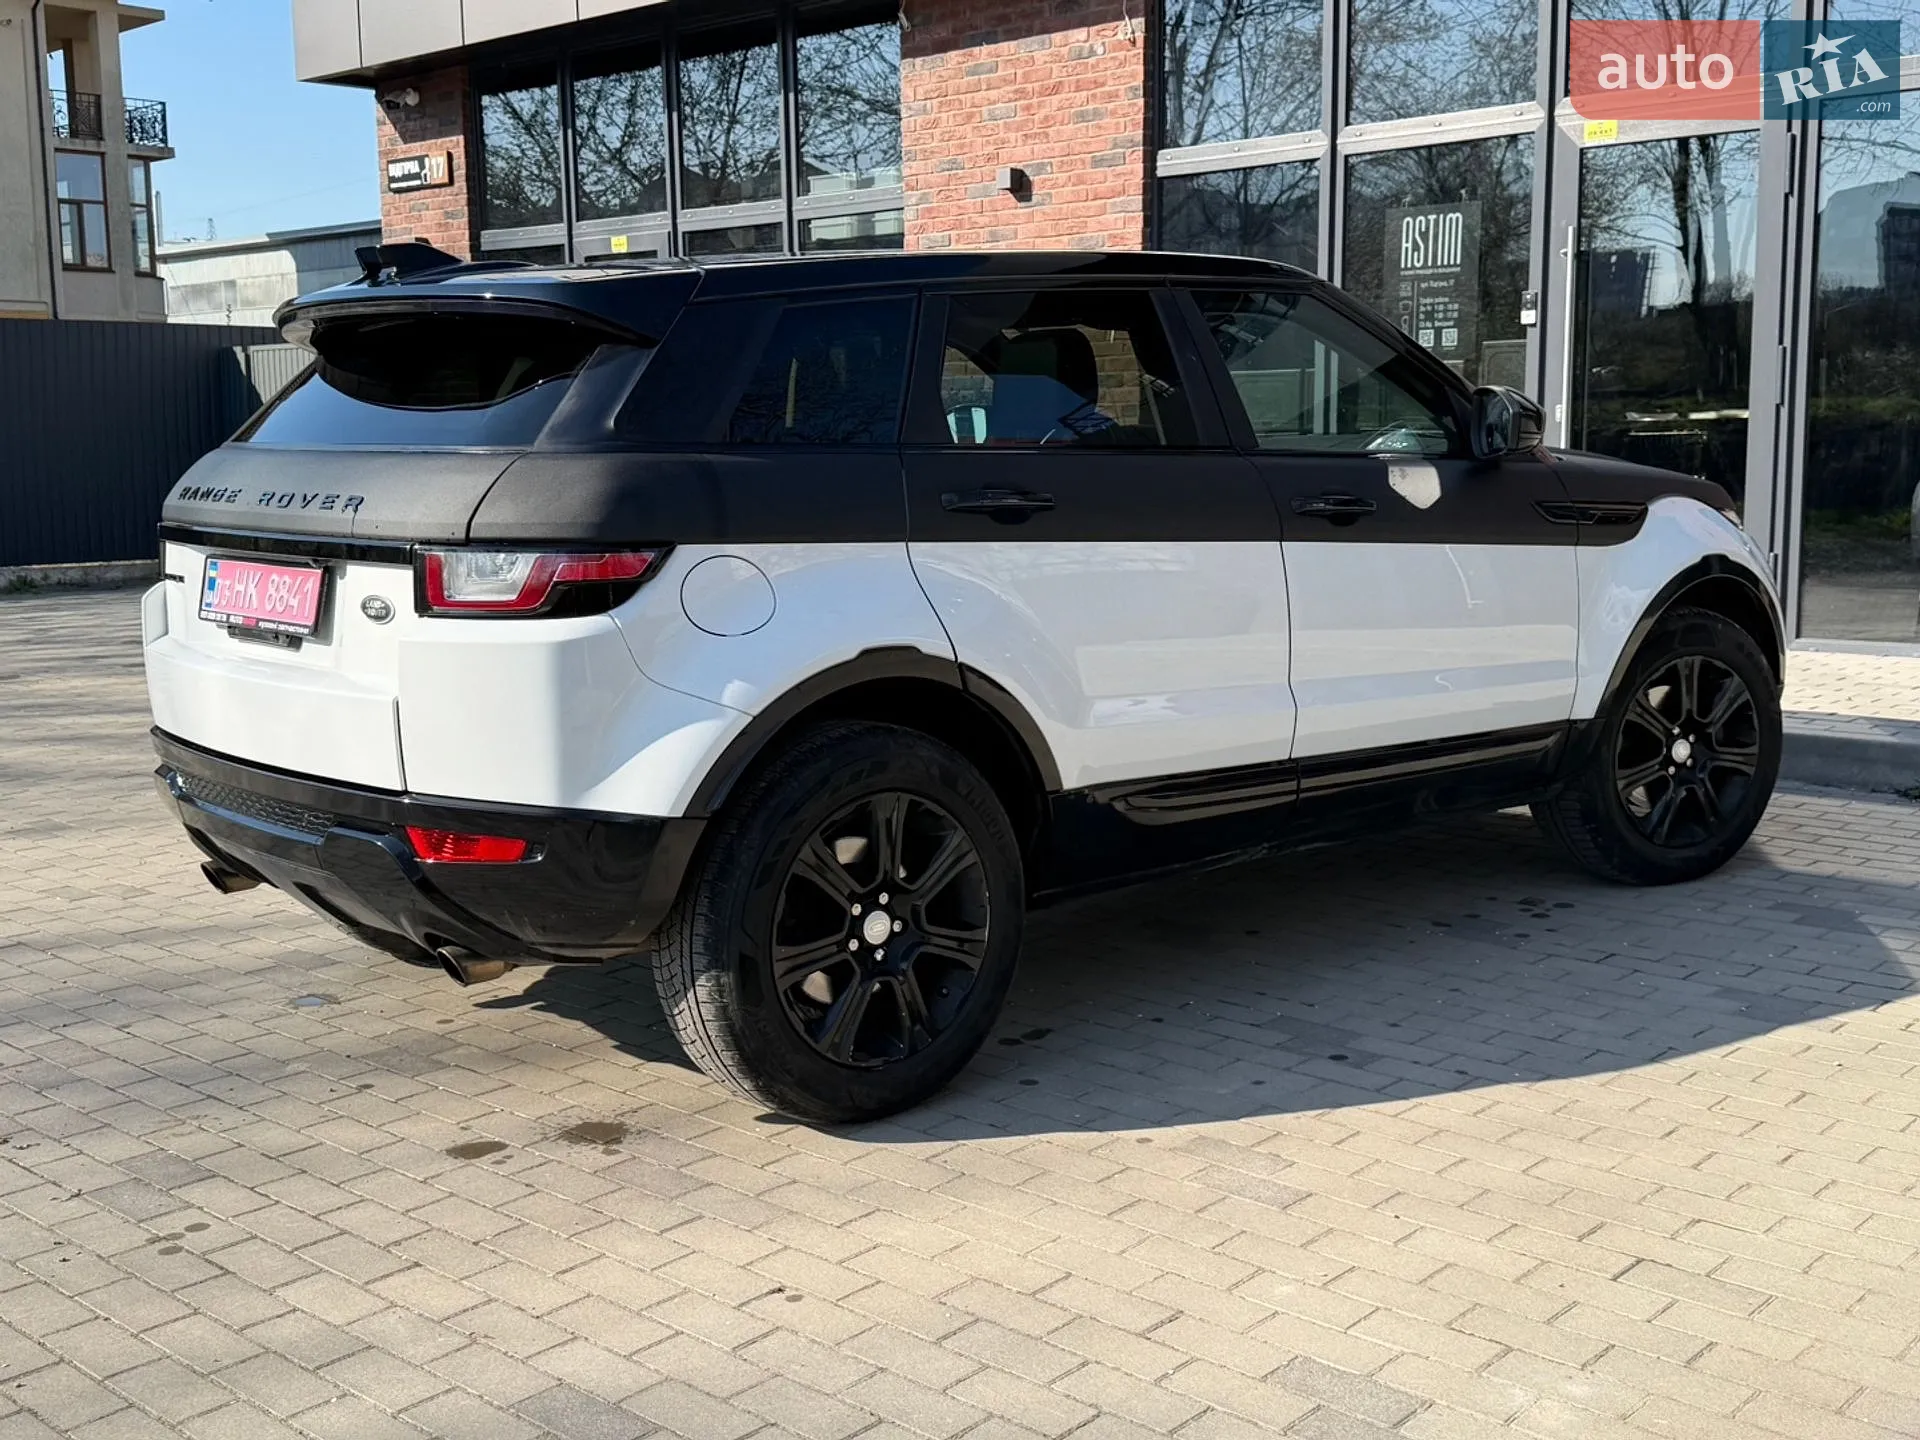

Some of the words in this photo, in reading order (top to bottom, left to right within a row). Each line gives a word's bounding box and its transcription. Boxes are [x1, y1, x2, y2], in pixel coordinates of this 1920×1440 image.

[430, 156, 444, 179] 17
[1400, 212, 1463, 269] ASTIM
[177, 487, 243, 504] RANGE
[257, 491, 366, 514] ROVER
[264, 573, 317, 617] 8841
